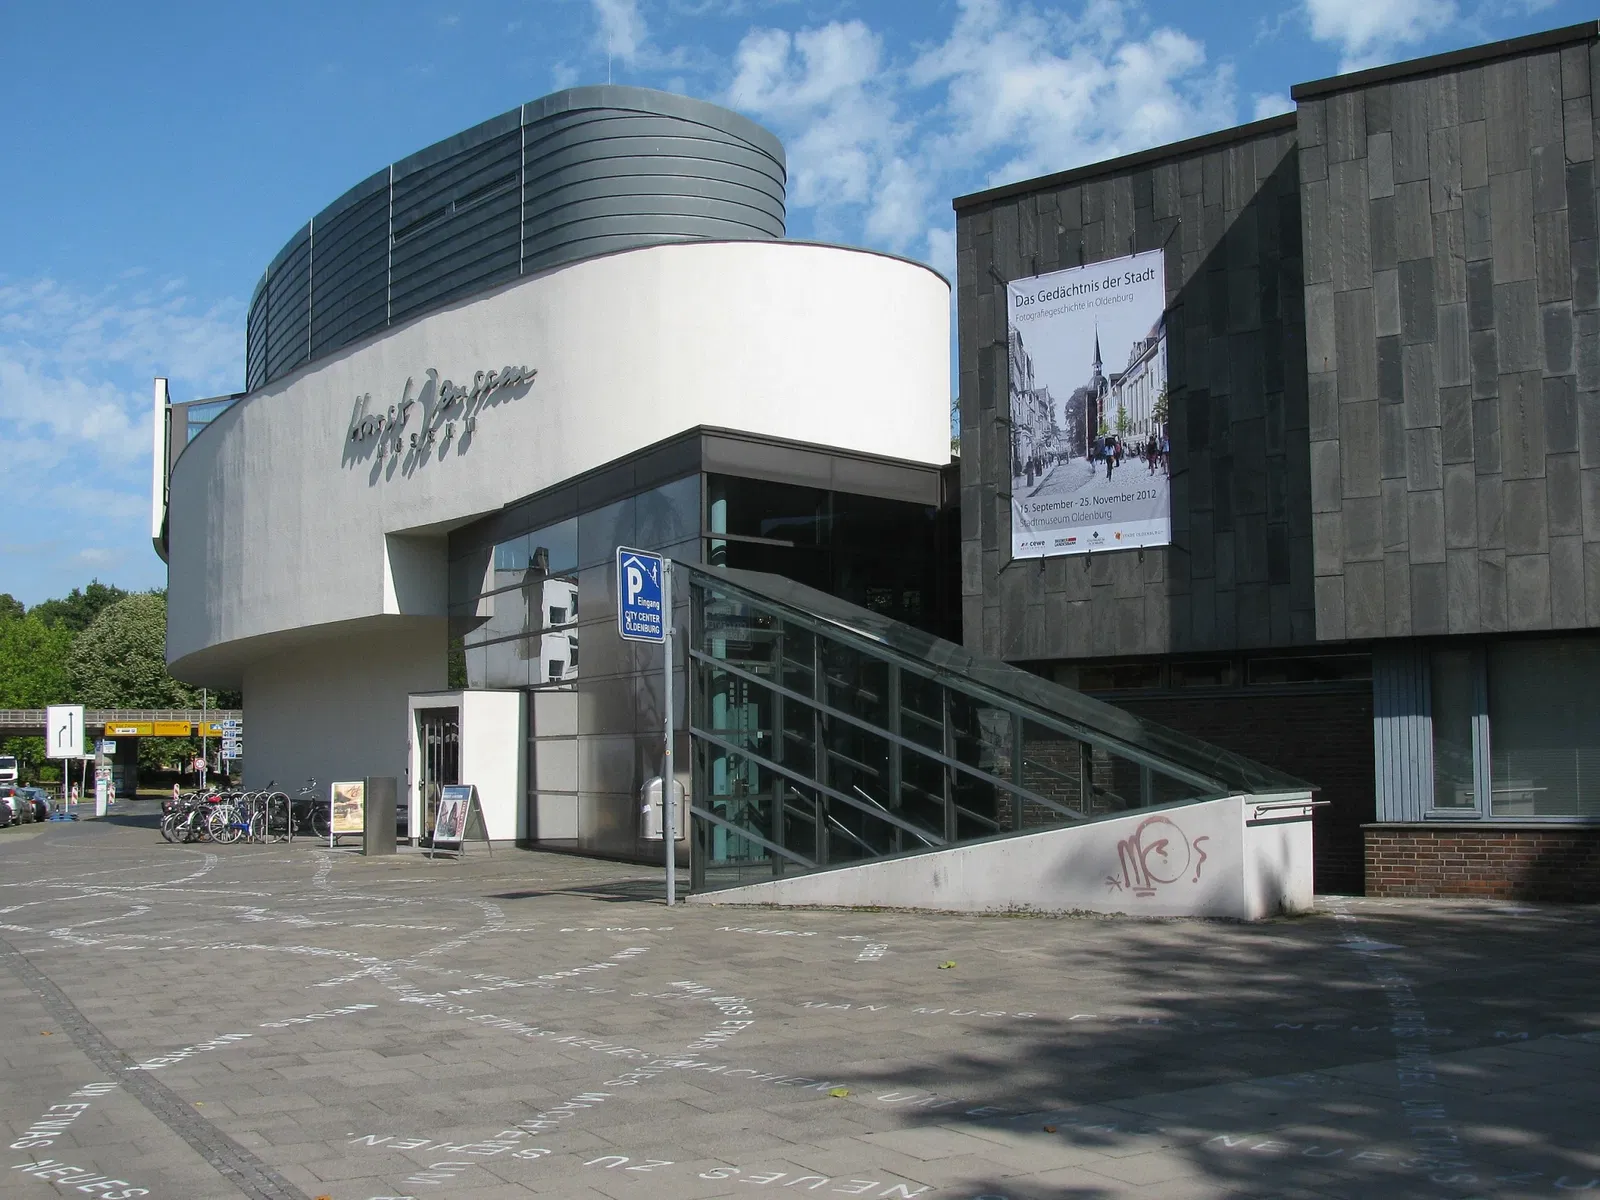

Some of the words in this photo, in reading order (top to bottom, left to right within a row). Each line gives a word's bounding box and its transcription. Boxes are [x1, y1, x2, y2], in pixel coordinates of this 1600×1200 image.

[1015, 294, 1035, 308] Das
[1037, 279, 1100, 302] Gedächtnis
[1102, 276, 1122, 290] der
[1124, 267, 1155, 285] Stadt
[1015, 302, 1085, 323] Fotografiegeschichte
[1087, 299, 1094, 309] in
[1095, 292, 1134, 307] Oldenburg
[1019, 504, 1031, 514] 15.
[1032, 498, 1074, 513] September
[1080, 497, 1092, 507] 25.
[1093, 493, 1135, 505] November
[1137, 489, 1157, 500] 2012
[1019, 514, 1070, 528] Stadtmuseum
[1072, 510, 1112, 524] Oldenburg
[627, 566, 643, 605] P
[637, 596, 660, 611] Eingang
[625, 611, 638, 621] CITY
[638, 612, 660, 623] CENTER
[625, 621, 660, 634] OLDENBURG
[259, 1003, 379, 1028] NEUES
[466, 1014, 556, 1037] ETWAS
[877, 1092, 958, 1109] UM
[69, 1082, 118, 1098] UM
[10, 1102, 91, 1150] ETWAS
[401, 1161, 477, 1184] UM
[583, 1155, 676, 1172] ZU
[11, 1159, 149, 1200] NEUES
[699, 1166, 929, 1199] NEUES
